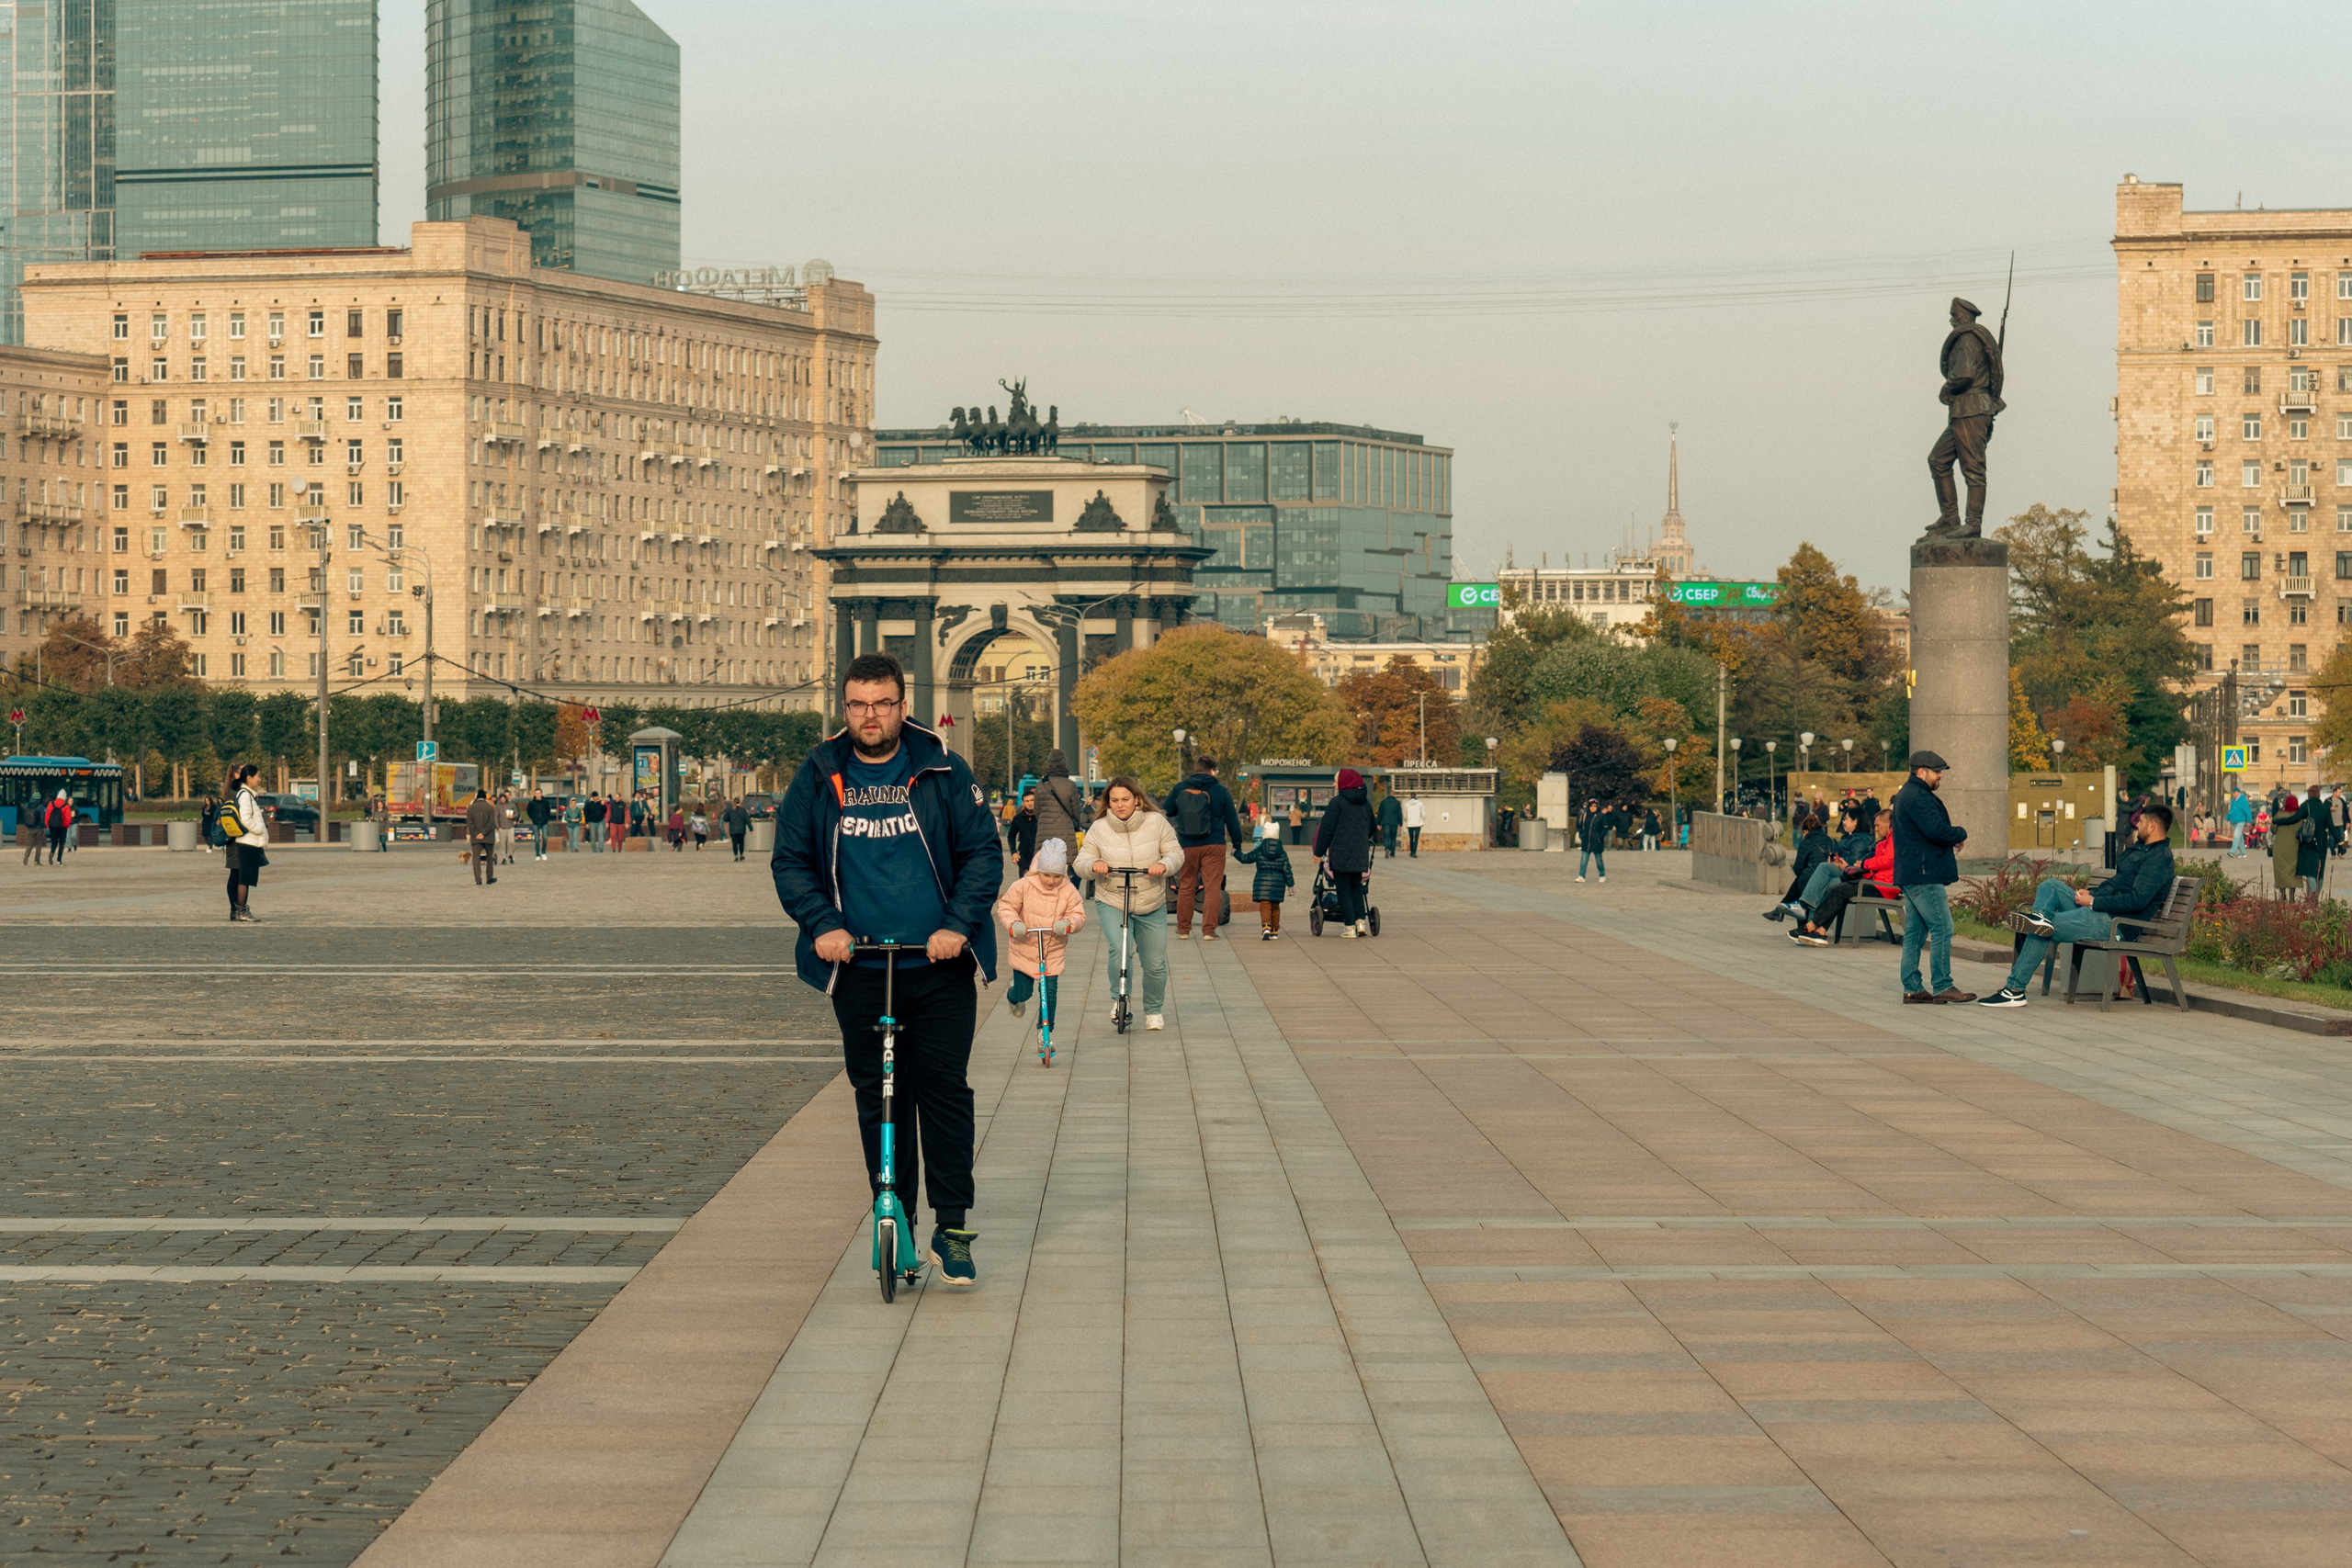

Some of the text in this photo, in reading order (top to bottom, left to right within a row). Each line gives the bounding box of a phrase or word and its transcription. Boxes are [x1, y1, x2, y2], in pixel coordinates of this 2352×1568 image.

[1685, 588, 1718, 600] СБЕР
[1261, 758, 1312, 767] МОРОЖЕНОЕ
[1403, 760, 1438, 769] ПРЕССА
[840, 813, 918, 838] SPIRATIO
